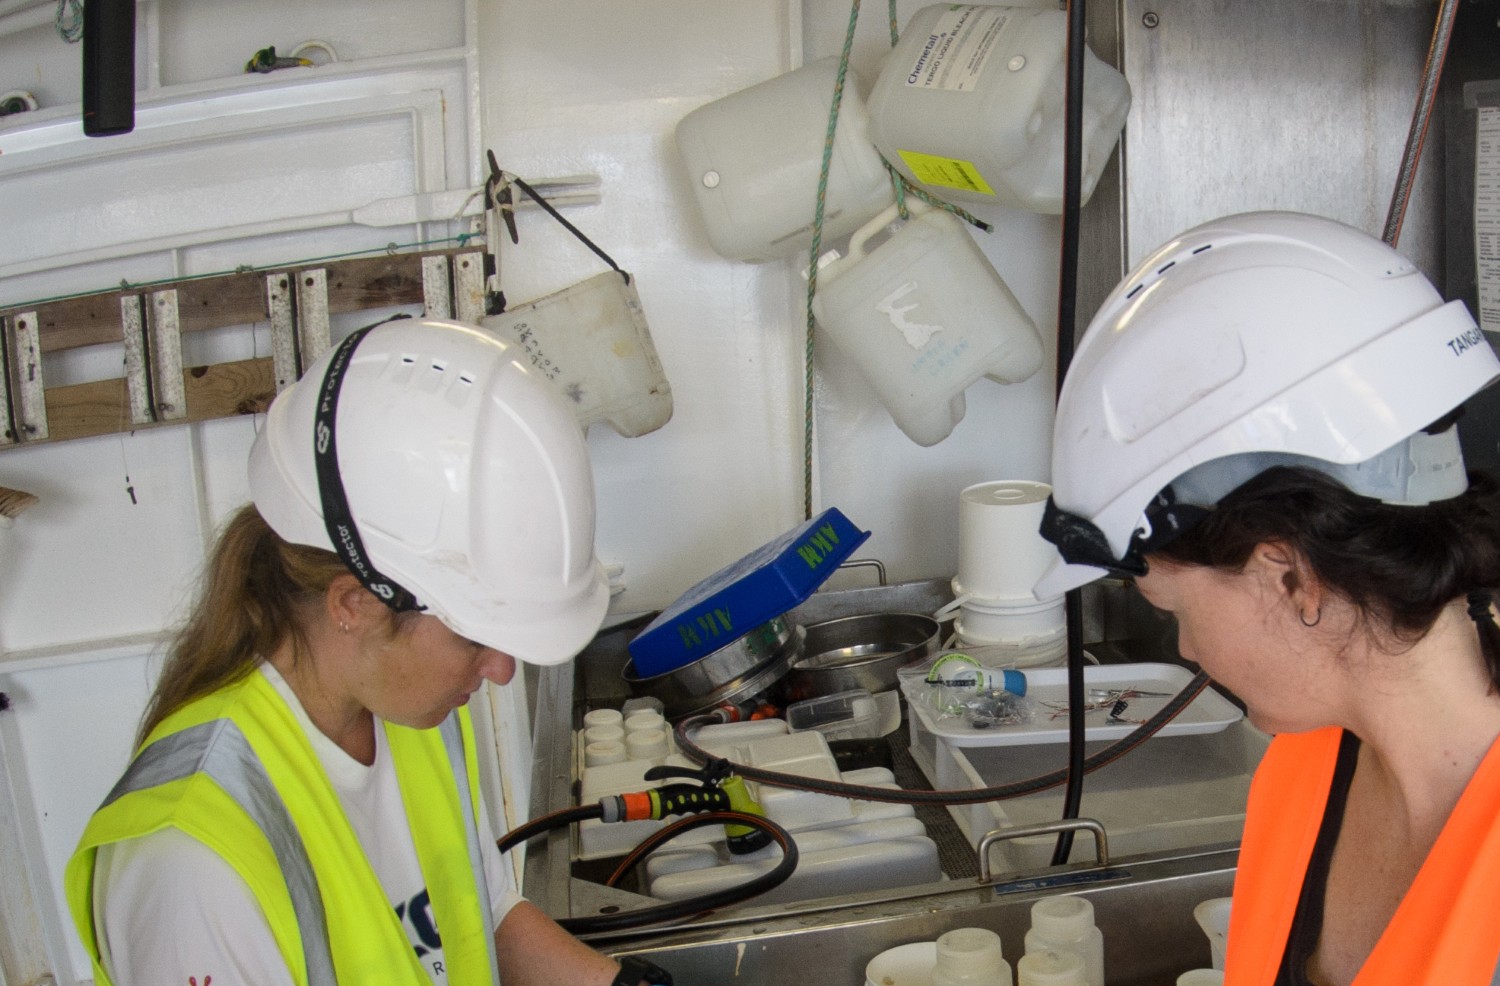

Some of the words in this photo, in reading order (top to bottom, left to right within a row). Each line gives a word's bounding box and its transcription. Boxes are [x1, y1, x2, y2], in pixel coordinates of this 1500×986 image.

[907, 34, 939, 84] Chemetall
[939, 37, 953, 60] LIQUID
[951, 11, 971, 36] BLEACH
